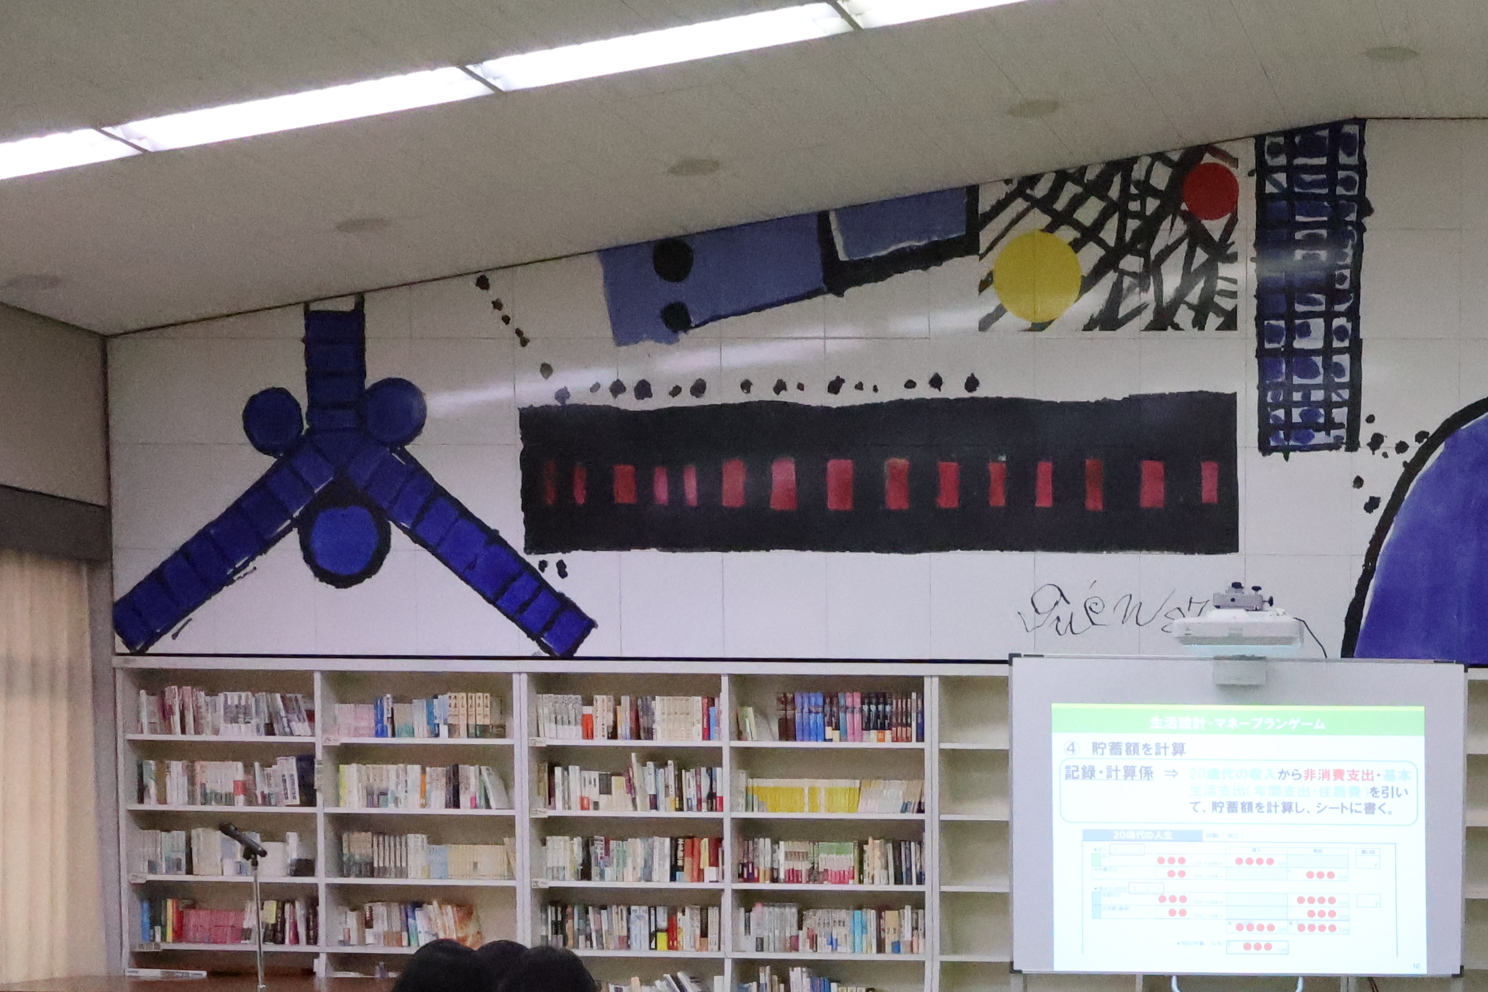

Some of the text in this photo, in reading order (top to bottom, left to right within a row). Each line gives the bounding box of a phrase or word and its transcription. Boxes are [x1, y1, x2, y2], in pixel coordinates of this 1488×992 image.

[1092, 741, 1186, 757] 貯蓄額を計算
